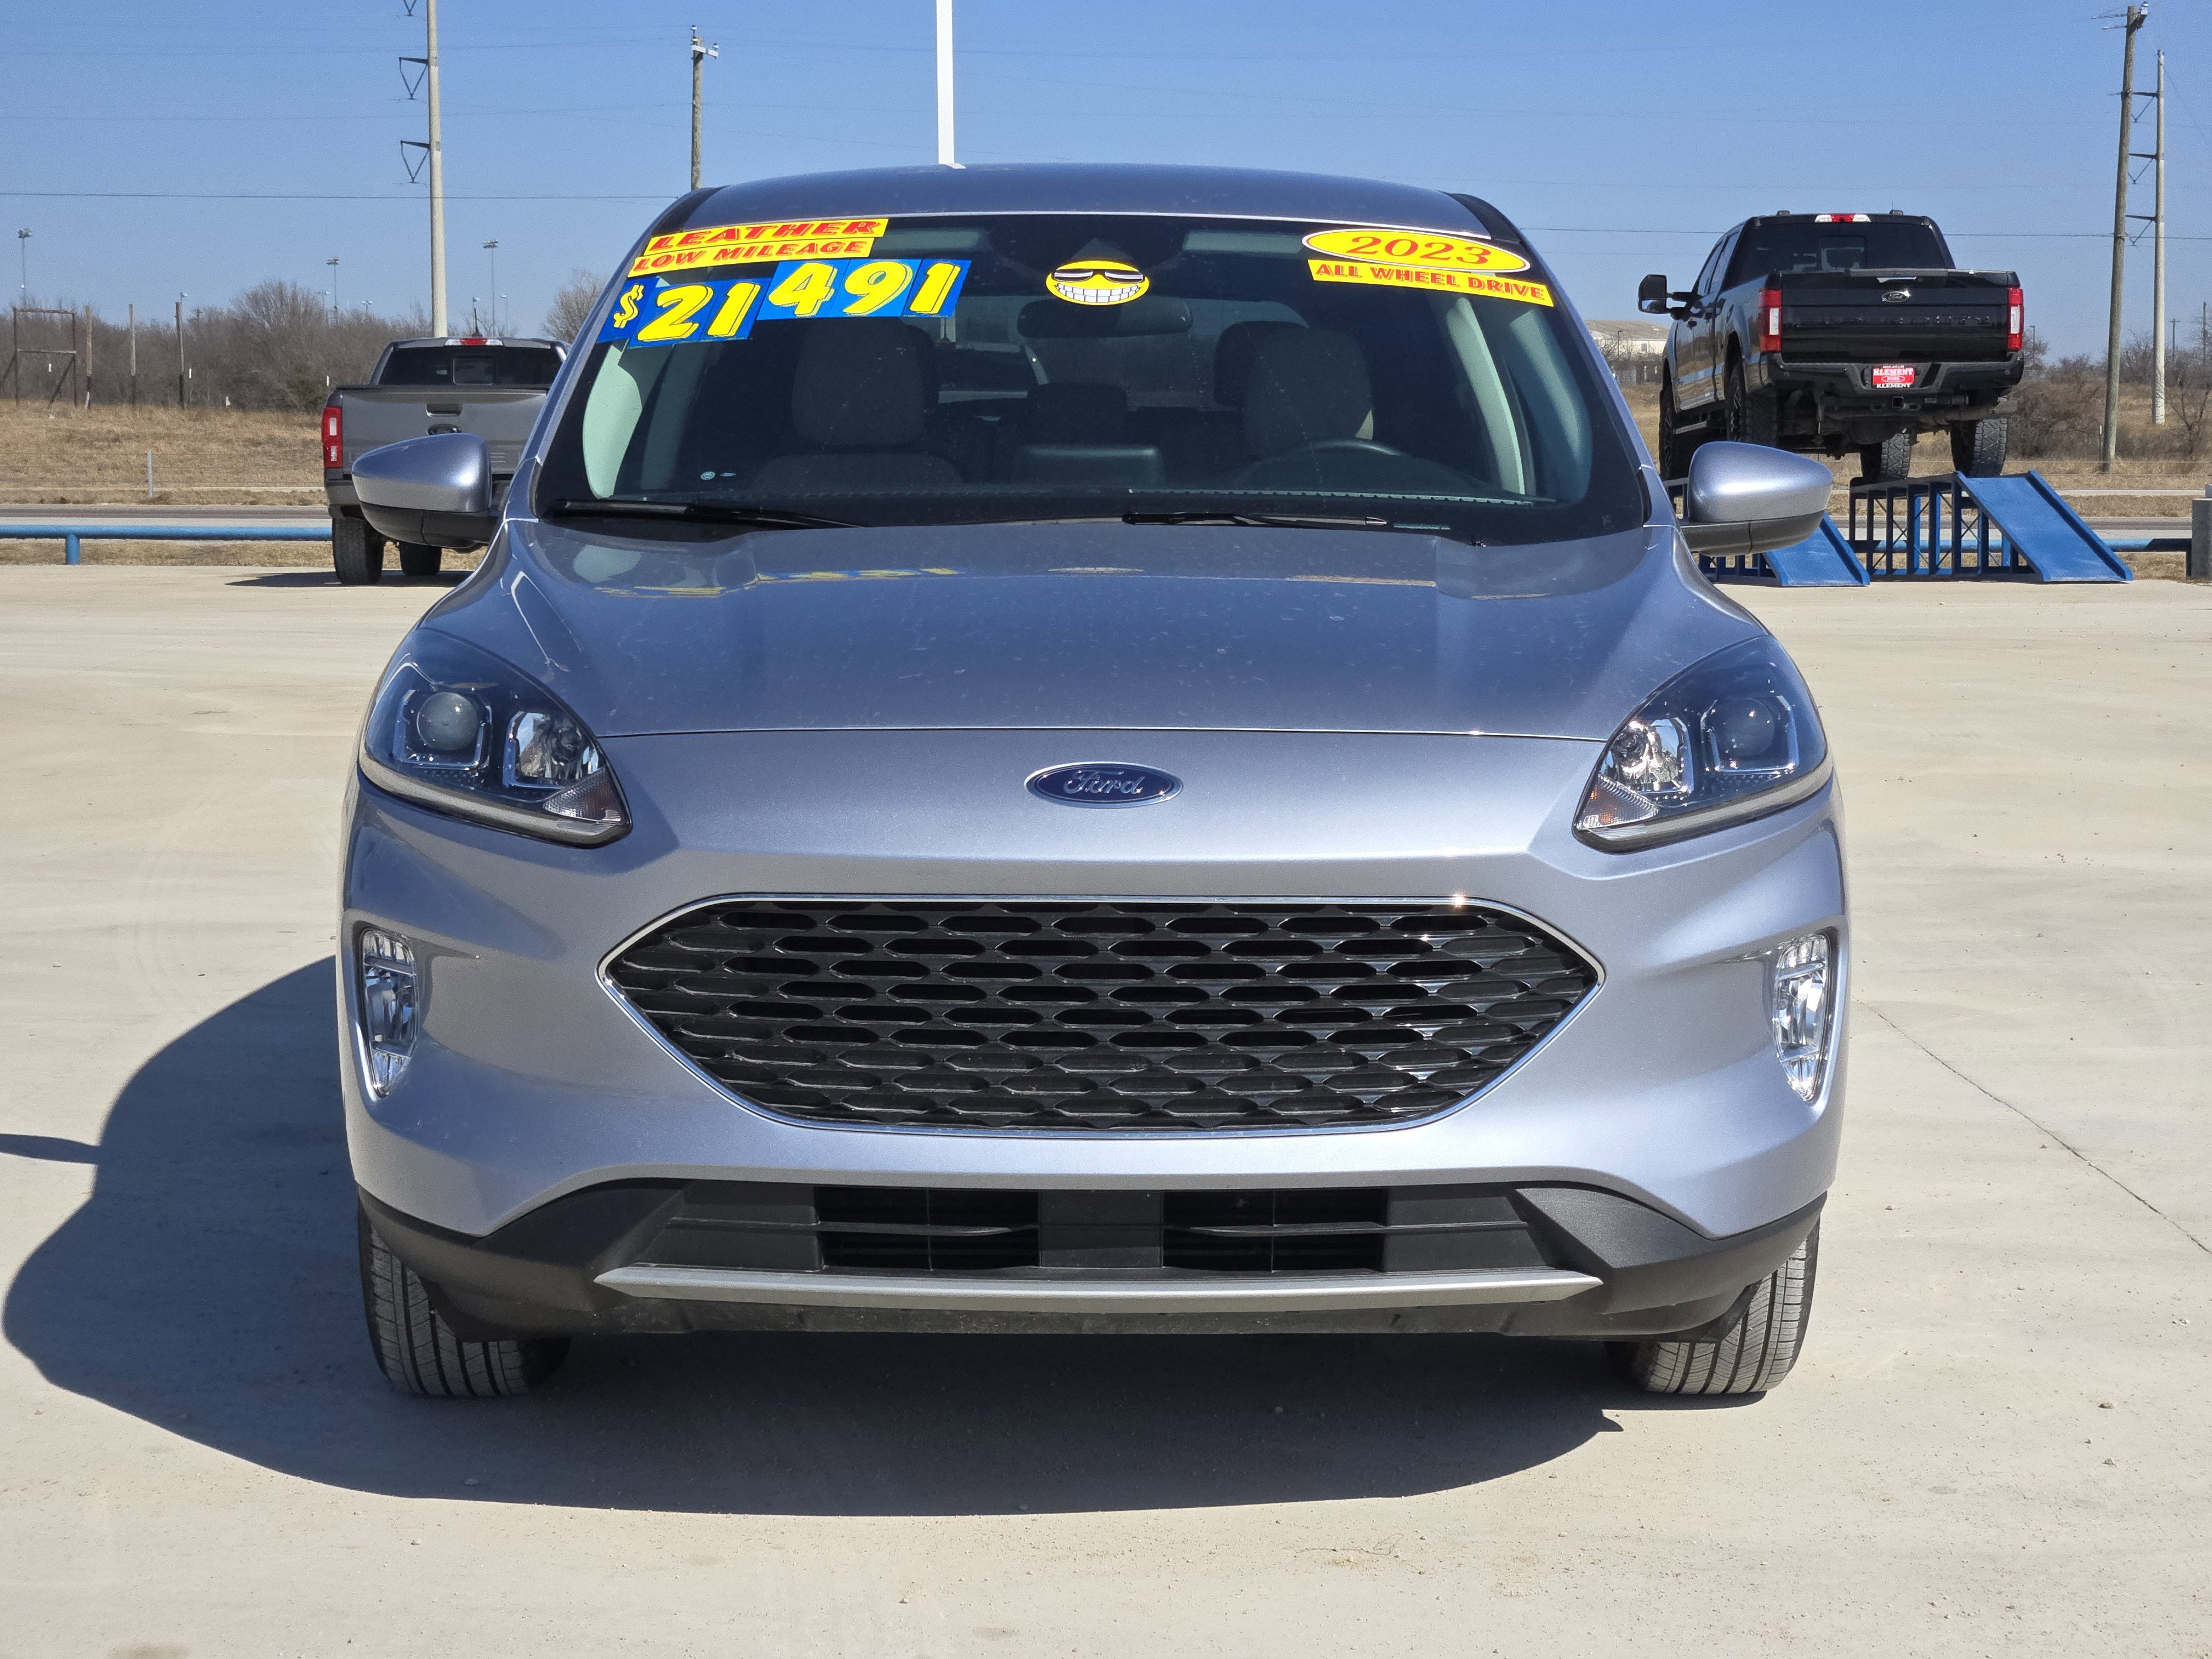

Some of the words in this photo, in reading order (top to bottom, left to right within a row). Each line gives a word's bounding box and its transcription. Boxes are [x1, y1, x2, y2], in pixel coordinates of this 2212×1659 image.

[649, 220, 880, 252] LEATHER
[1345, 236, 1492, 264] 2023
[633, 251, 706, 272] LOW
[713, 241, 863, 262] MILEAGE
[1316, 263, 1362, 278] ALL
[1370, 267, 1460, 288] WHEEL
[1468, 278, 1546, 301] DRIVE
[1063, 770, 1145, 794] Ford
